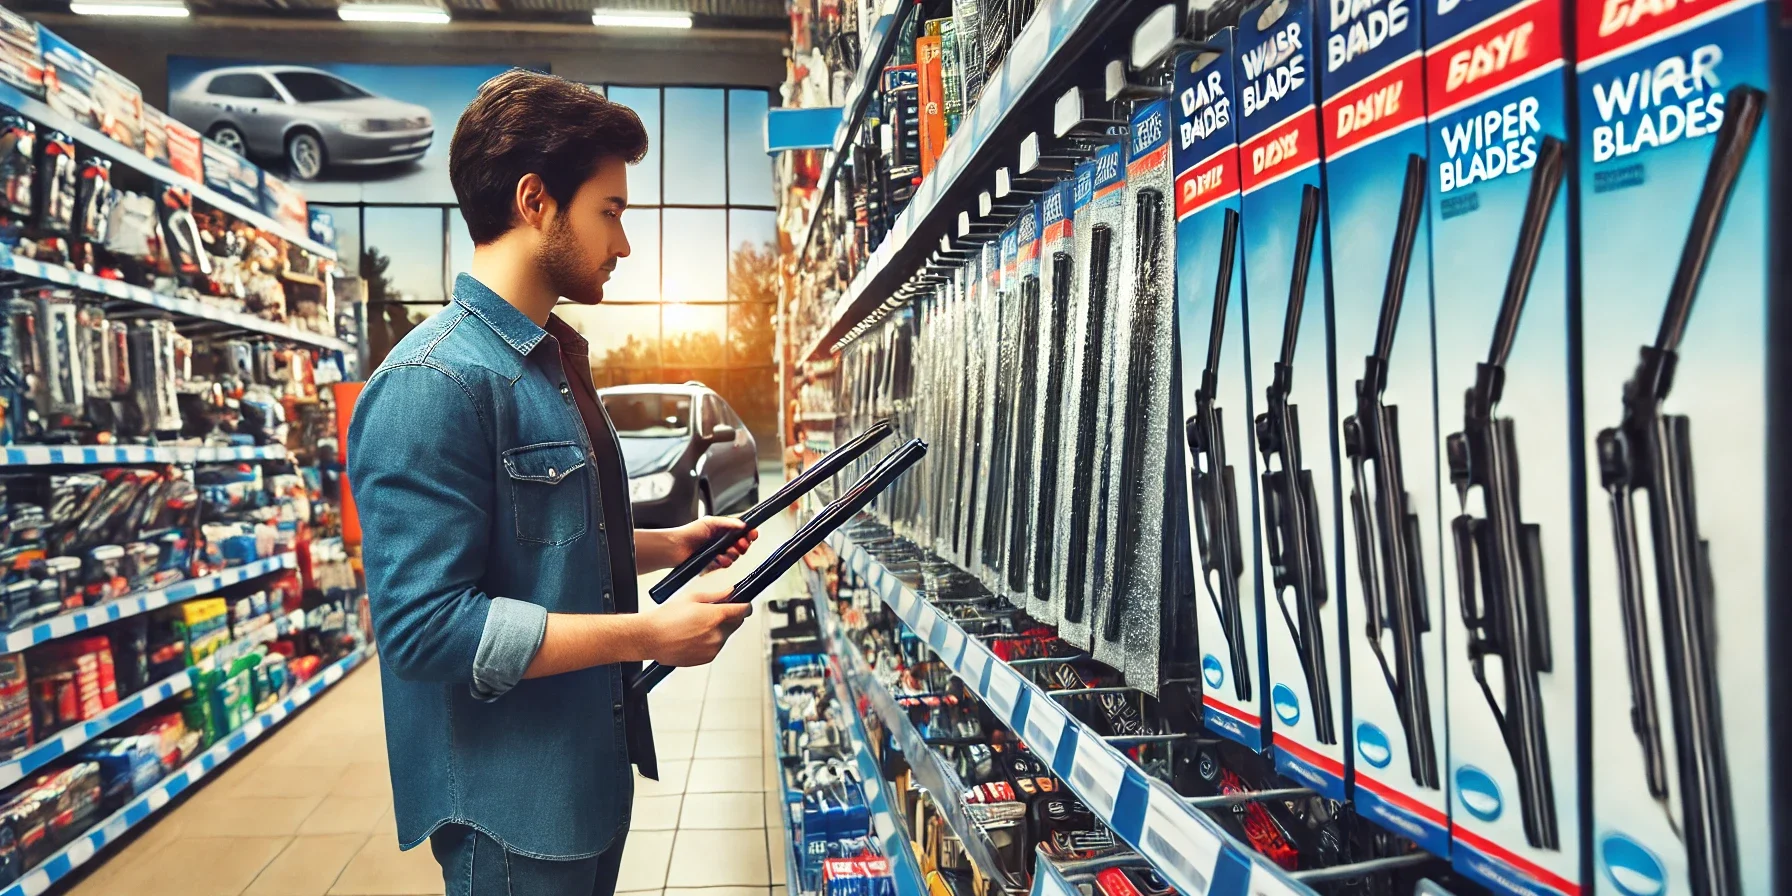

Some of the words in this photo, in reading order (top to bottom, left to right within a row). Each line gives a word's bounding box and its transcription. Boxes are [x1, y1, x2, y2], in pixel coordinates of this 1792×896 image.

[1441, 96, 1540, 159] WIPER
[1593, 92, 1725, 163] BLADES
[1440, 136, 1538, 193] BLADES
